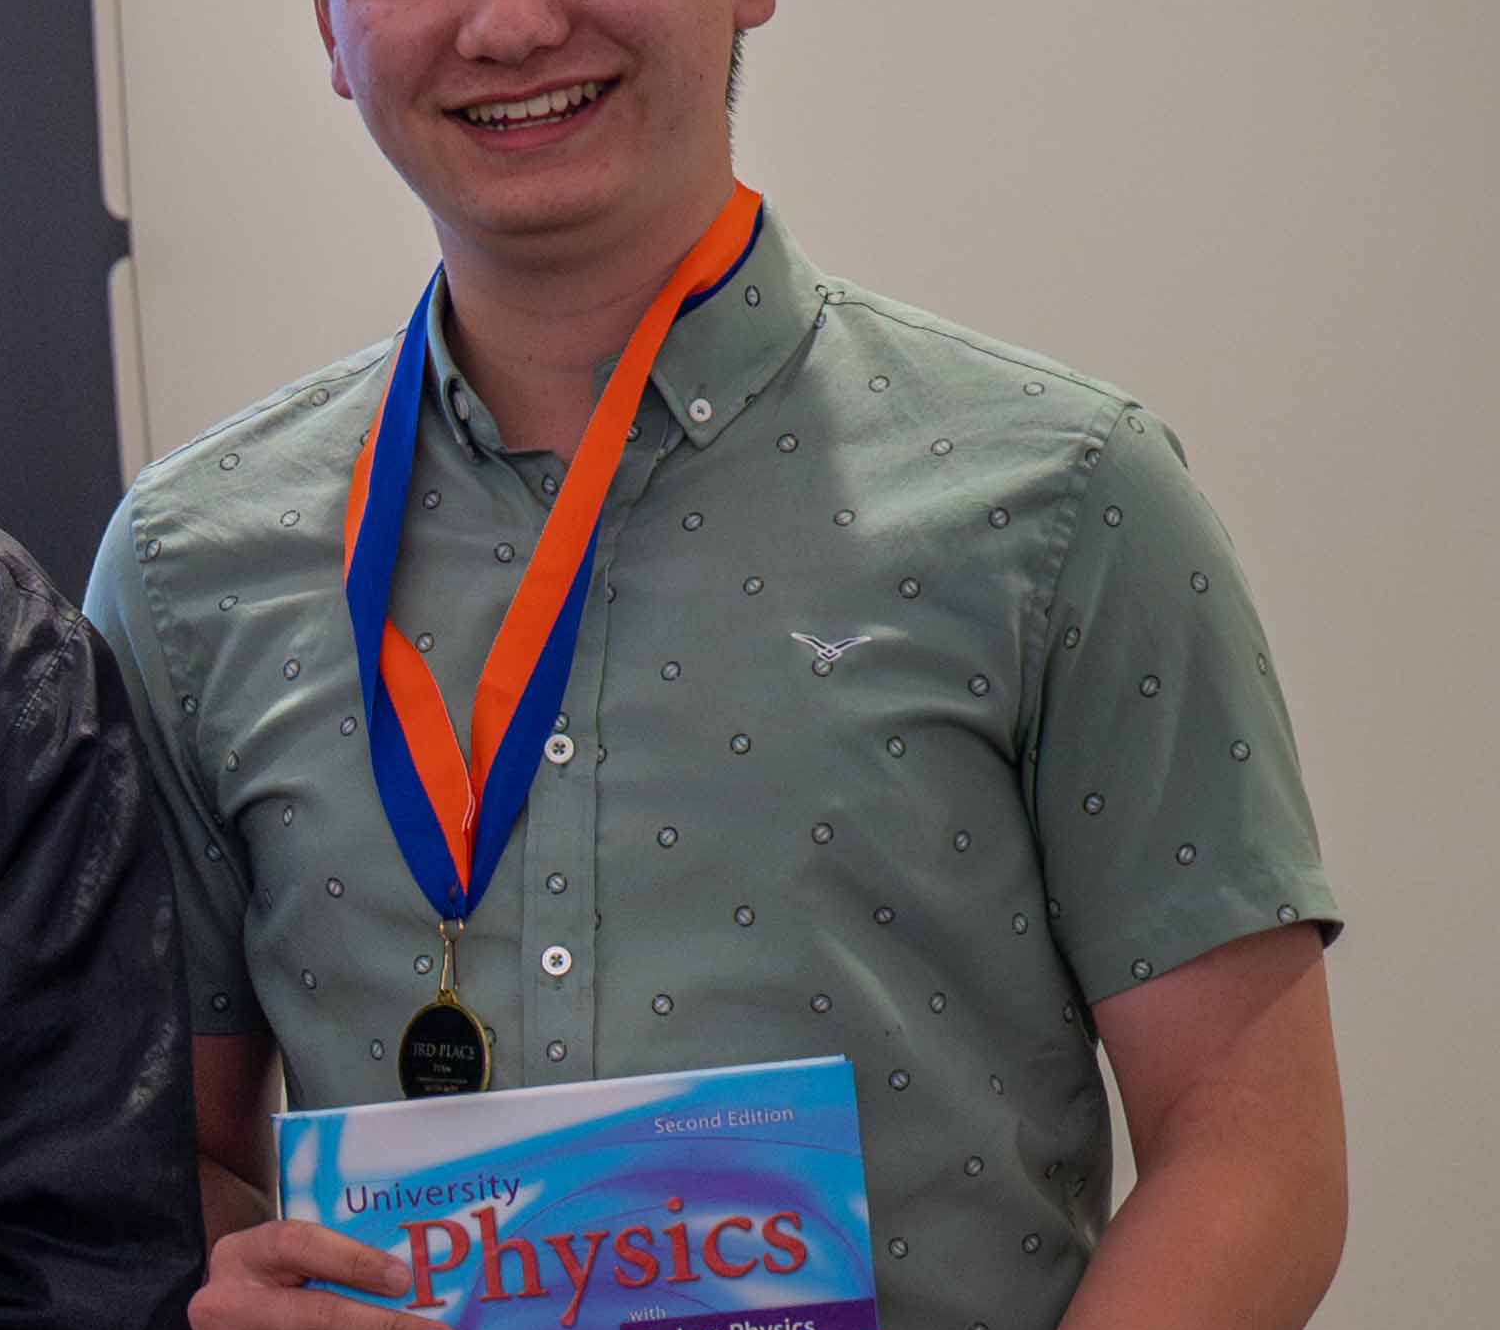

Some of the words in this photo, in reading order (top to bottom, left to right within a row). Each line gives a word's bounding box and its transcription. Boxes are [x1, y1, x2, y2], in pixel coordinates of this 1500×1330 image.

[652, 1114, 722, 1135] Second
[726, 1106, 795, 1128] Edition
[344, 1172, 522, 1216] University
[396, 1195, 808, 1329] Physics
[626, 1304, 668, 1323] with
